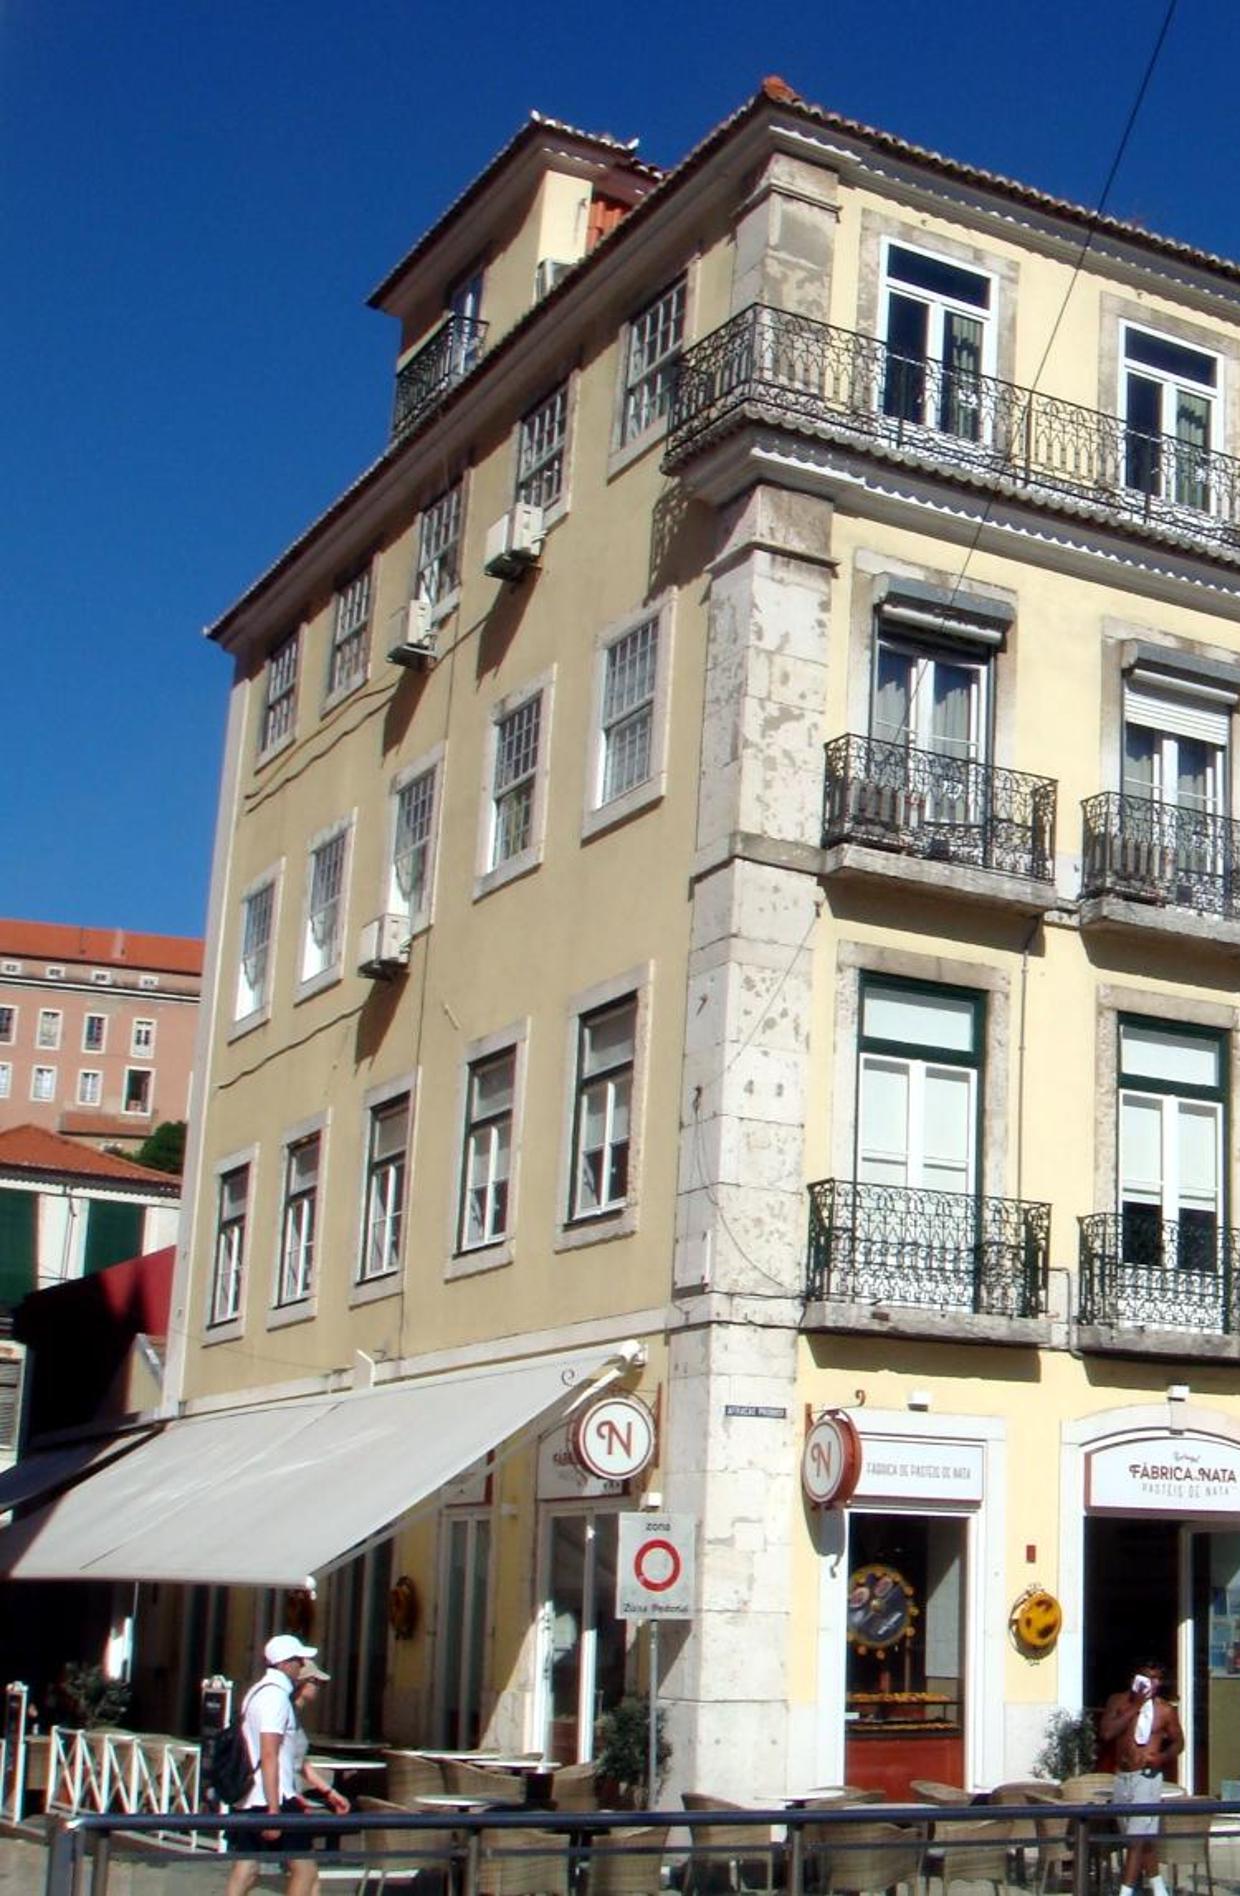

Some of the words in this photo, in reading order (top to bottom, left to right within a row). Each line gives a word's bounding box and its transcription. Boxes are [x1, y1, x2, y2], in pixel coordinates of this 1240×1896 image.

[596, 1420, 632, 1458] N
[811, 1441, 832, 1479] N
[1198, 1467, 1237, 1483] NATA
[1188, 1484, 1200, 1498] DE
[1205, 1484, 1230, 1496] NATA
